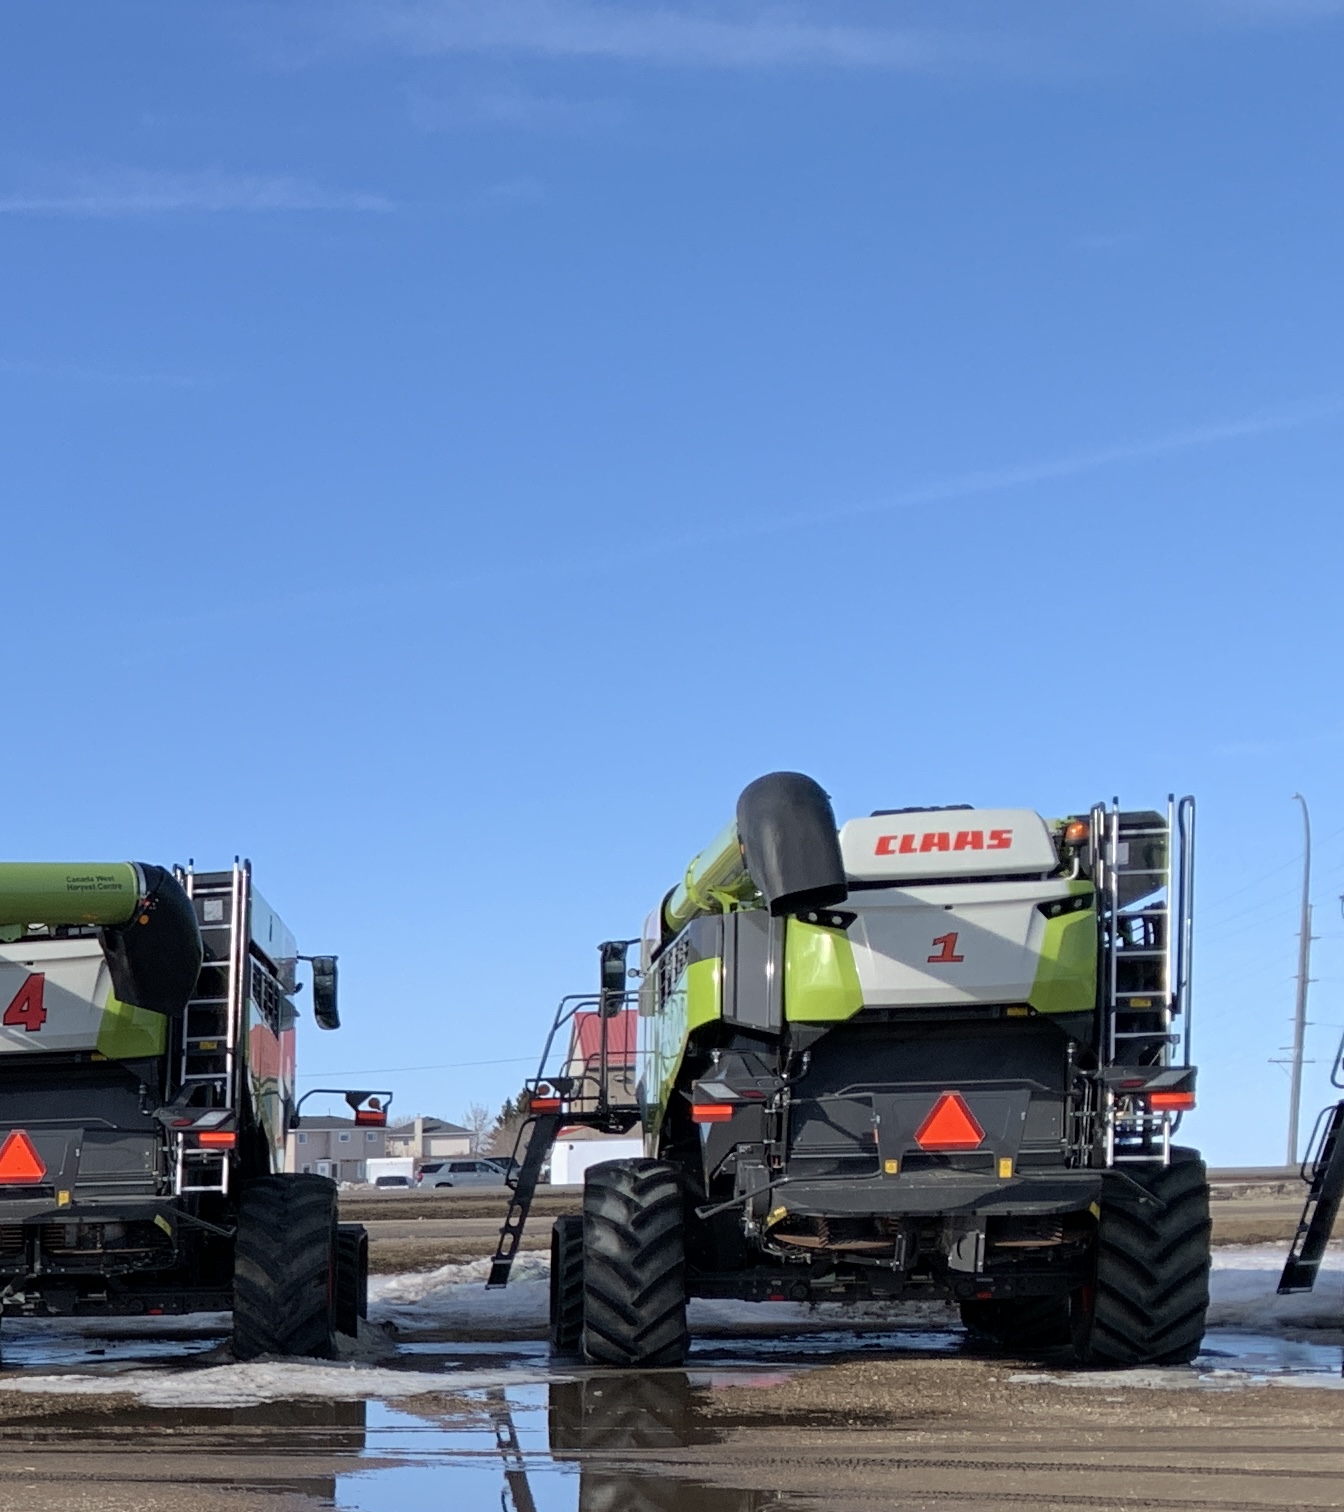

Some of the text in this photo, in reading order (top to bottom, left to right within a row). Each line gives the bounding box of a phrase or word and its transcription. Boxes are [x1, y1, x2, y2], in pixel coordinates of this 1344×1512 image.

[874, 829, 1014, 855] CLAAS
[66, 883, 96, 891] Harvest
[927, 931, 965, 964] 1
[3, 972, 47, 1032] 4
